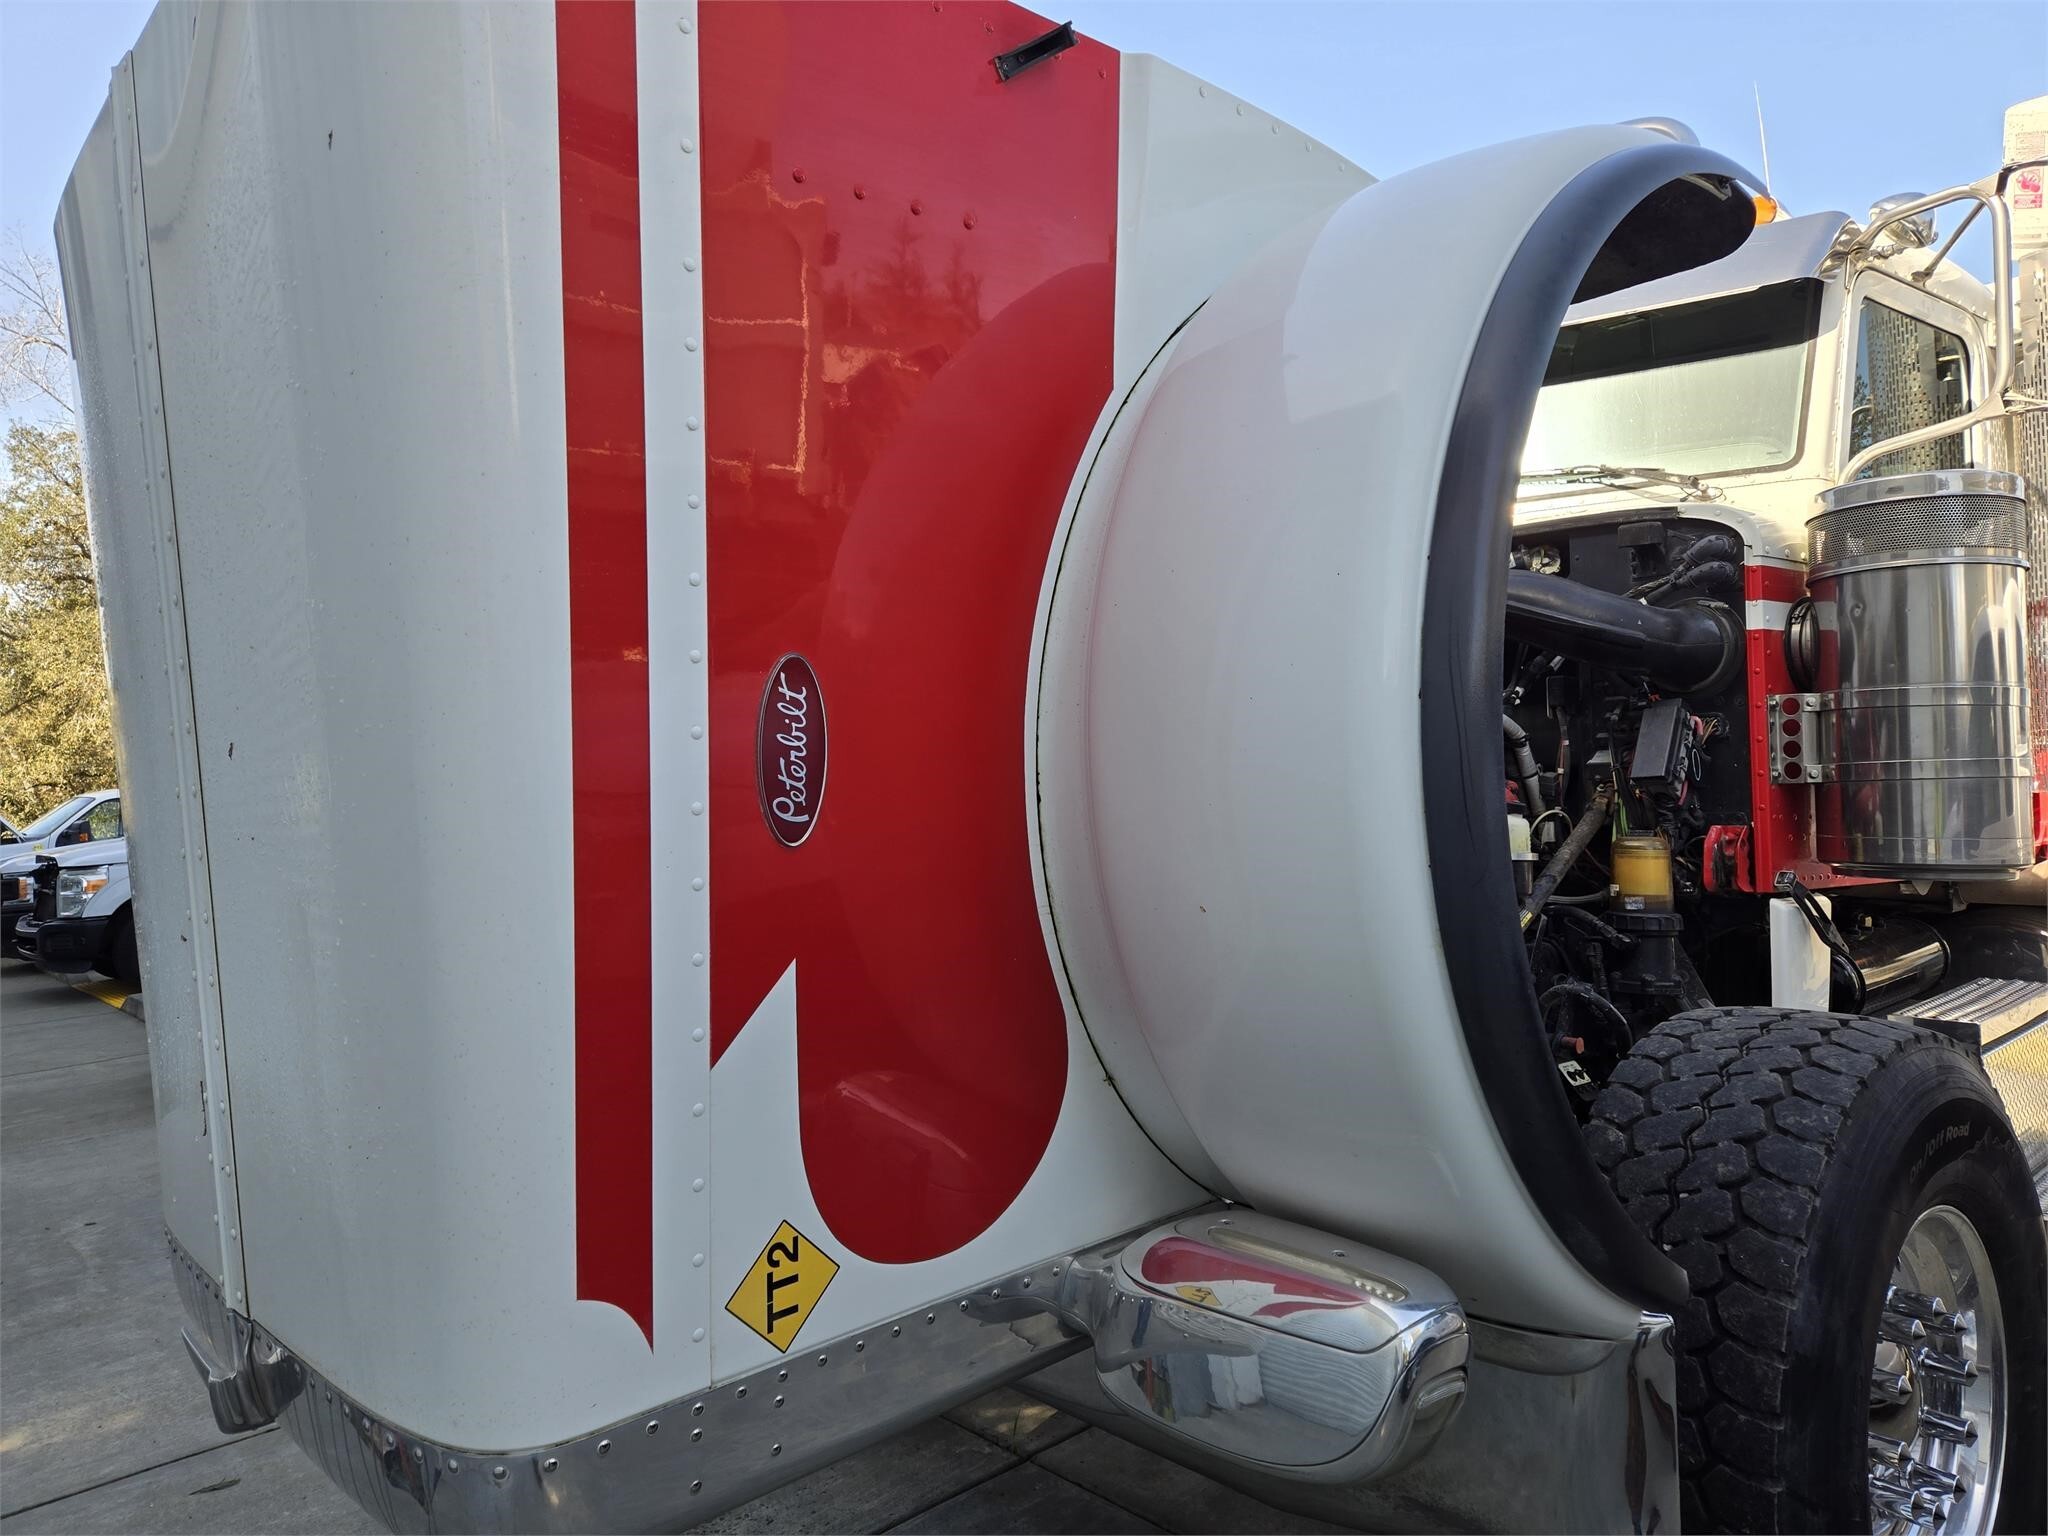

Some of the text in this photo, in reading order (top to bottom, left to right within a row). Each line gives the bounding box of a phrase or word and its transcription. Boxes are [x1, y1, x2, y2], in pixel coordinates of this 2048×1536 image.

[772, 671, 809, 822] Peterbilt
[1946, 1121, 1971, 1143] Road
[767, 1235, 798, 1334] TT2
